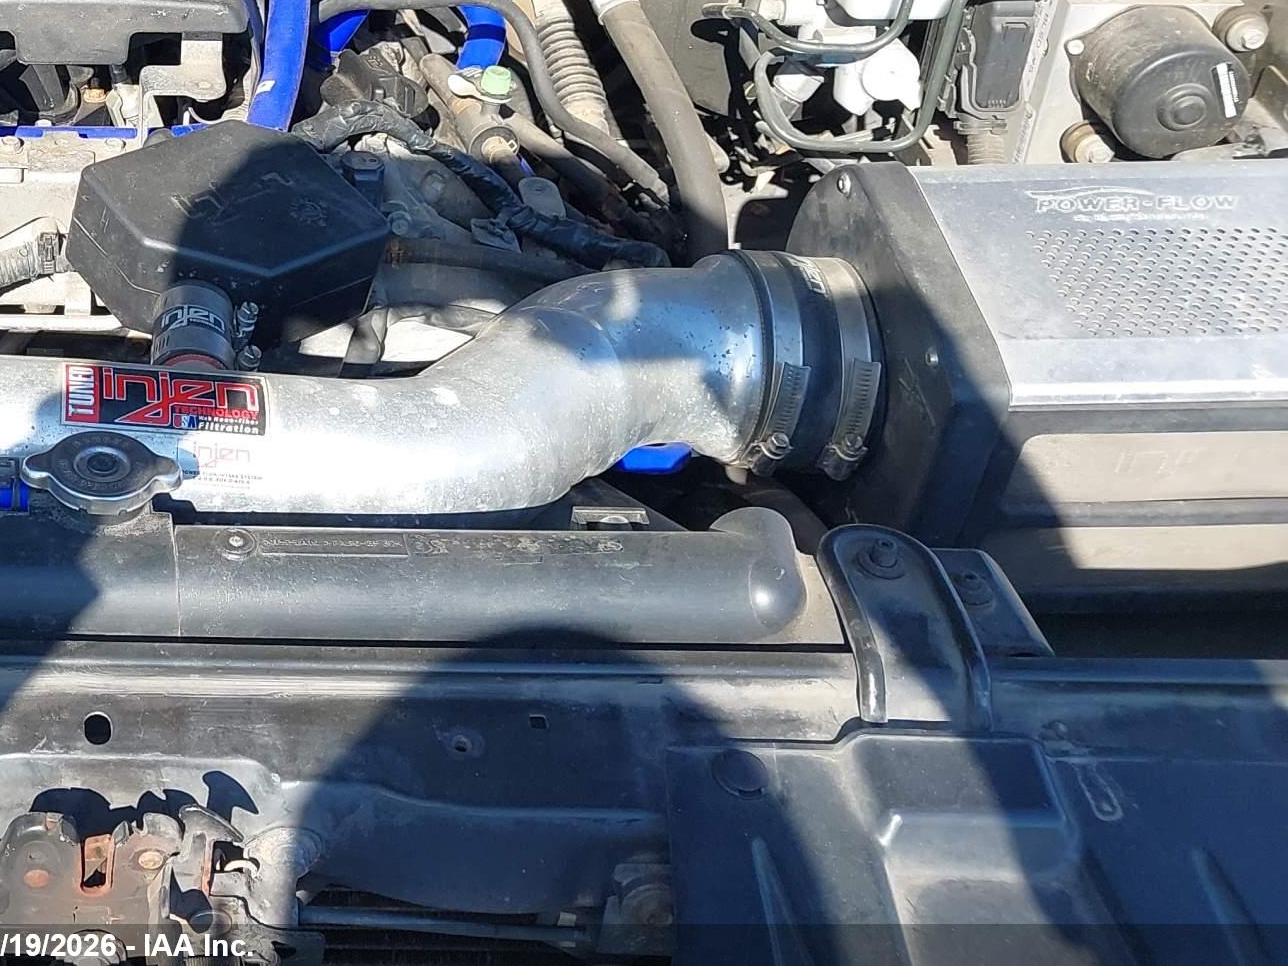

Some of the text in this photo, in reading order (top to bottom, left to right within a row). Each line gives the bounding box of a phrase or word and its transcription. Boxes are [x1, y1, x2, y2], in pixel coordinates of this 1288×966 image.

[160, 304, 225, 332] injen
[68, 366, 94, 416] TUNED
[103, 367, 260, 426] injen
[173, 406, 258, 420] TECHNOLOGY
[173, 414, 197, 429] USA
[198, 421, 259, 434] Filtration
